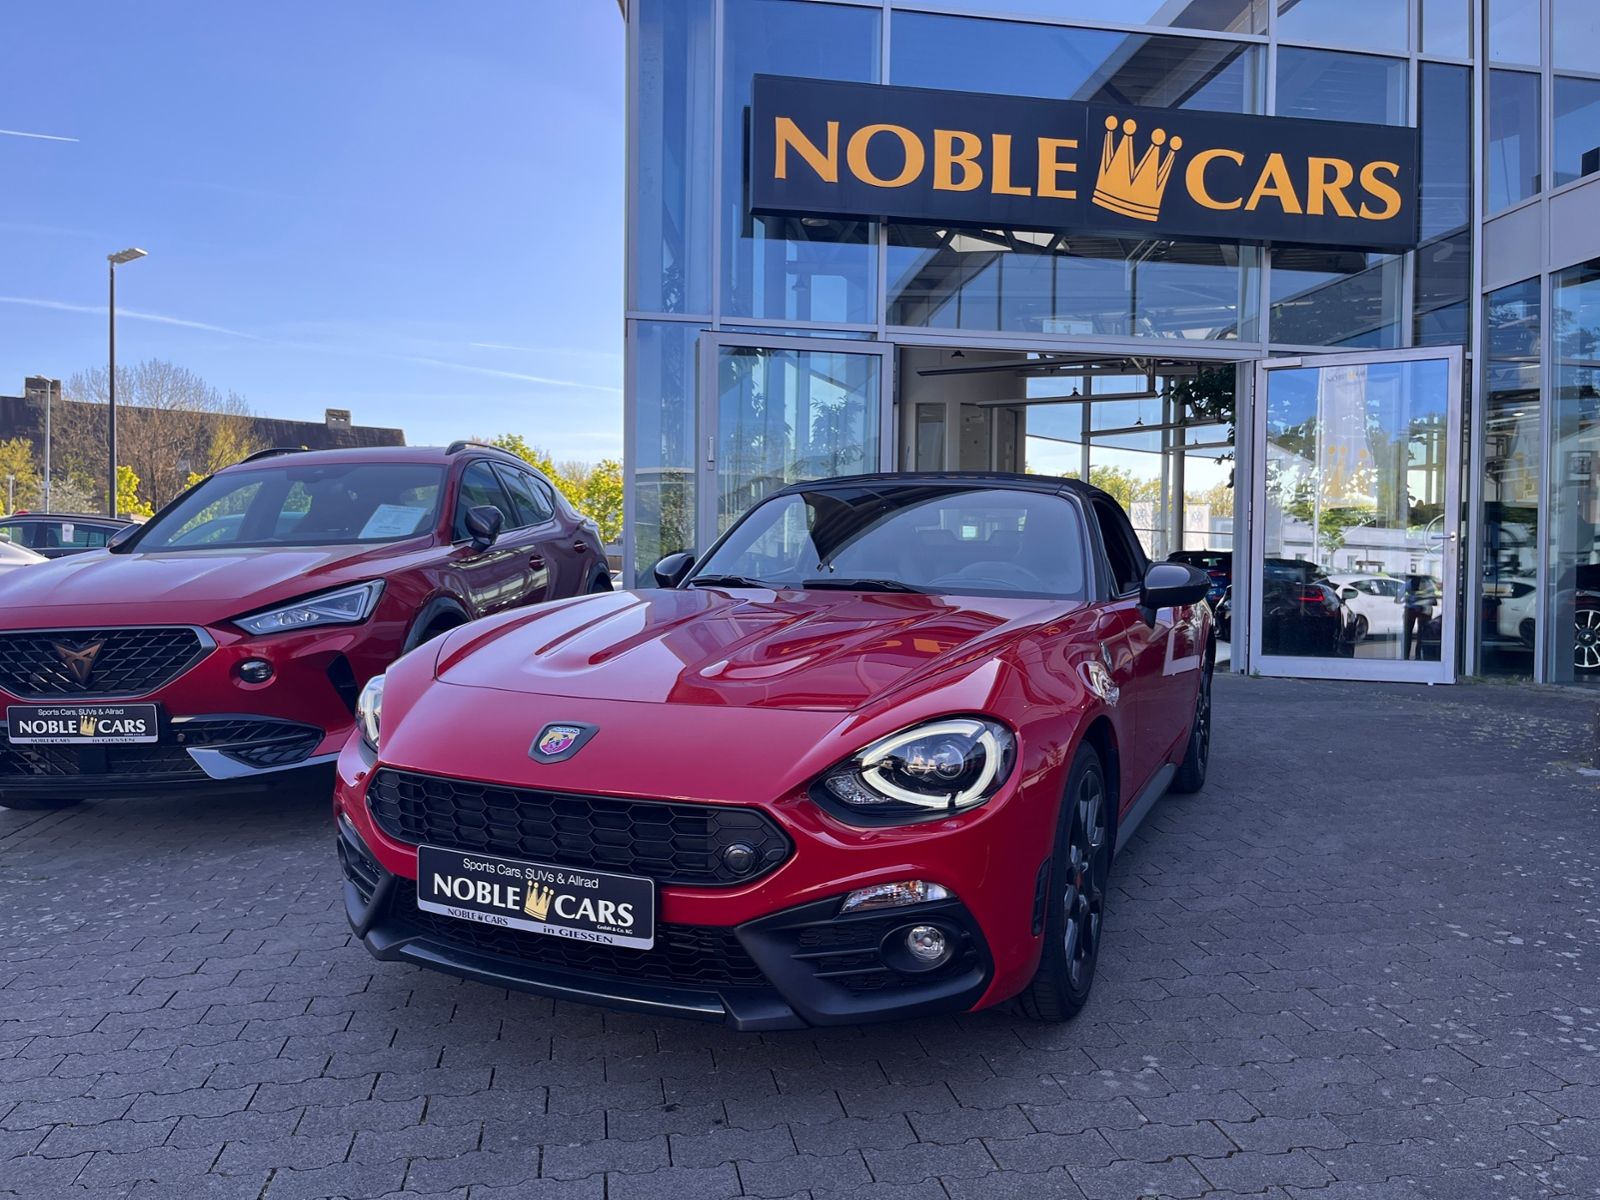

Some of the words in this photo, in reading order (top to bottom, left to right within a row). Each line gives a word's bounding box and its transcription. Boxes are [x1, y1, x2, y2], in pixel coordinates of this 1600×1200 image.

[774, 116, 1078, 200] NOBLE
[1184, 148, 1402, 222] CARS
[78, 708, 97, 716] SUVs
[19, 720, 78, 734] NOBLE
[98, 719, 146, 734] CARS
[463, 858, 496, 875] Sports
[497, 864, 524, 879] Cars,
[525, 868, 555, 883] SUVs
[557, 872, 566, 885] &
[567, 874, 600, 889] Allrad
[433, 872, 521, 910] NOBLE
[554, 894, 635, 927] CARS
[447, 907, 478, 920] NOBLE
[484, 914, 509, 926] CARS
[543, 925, 555, 934] in
[559, 928, 614, 944] GIESSEN
